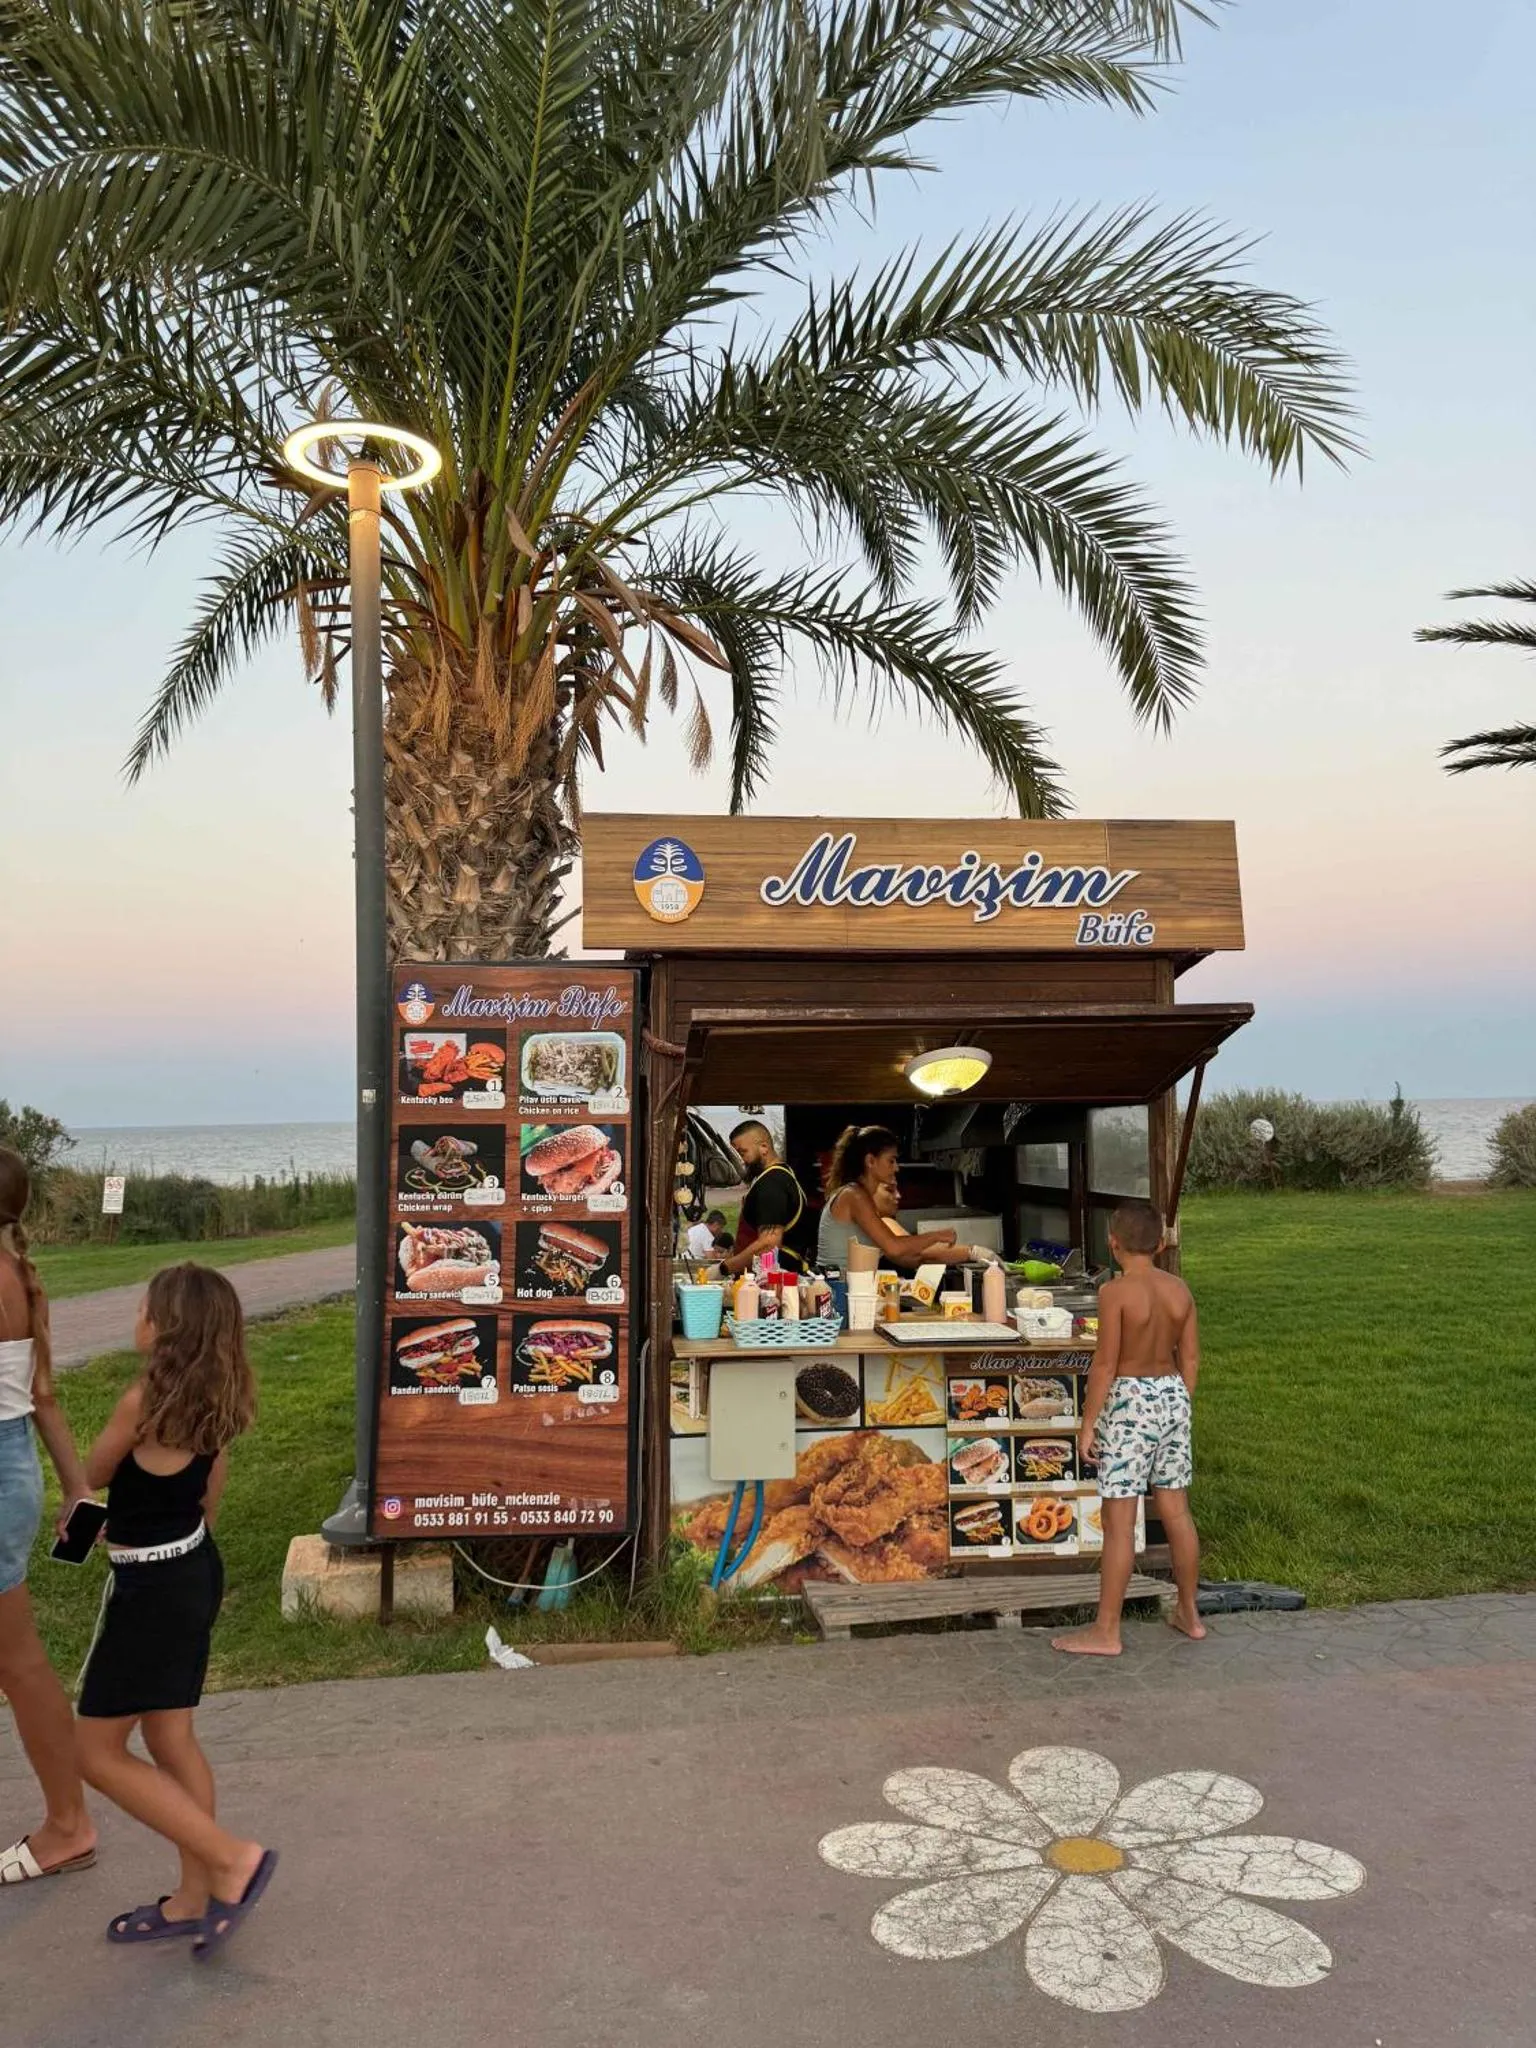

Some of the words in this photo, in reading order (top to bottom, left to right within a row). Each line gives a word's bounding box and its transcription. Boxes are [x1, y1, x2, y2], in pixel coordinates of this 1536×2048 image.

[760, 832, 1140, 922] Mavişim
[1075, 909, 1156, 946] Büfe
[441, 984, 557, 1024] Mavişim
[557, 985, 625, 1030] Büfe
[492, 1080, 497, 1091] 1
[615, 1086, 622, 1098] 2
[400, 1095, 437, 1106] Kentucky
[439, 1095, 454, 1104] box
[519, 1095, 538, 1104] Pilav
[519, 1106, 549, 1115] Chicken
[564, 1107, 580, 1115] rice
[488, 1177, 495, 1188] 3
[614, 1184, 621, 1194] 4
[398, 1192, 435, 1202] Kentucky
[436, 1192, 463, 1200] dürüm
[521, 1193, 556, 1202] Kentucky
[559, 1194, 585, 1202] burger
[398, 1204, 431, 1212] Chicken
[432, 1205, 453, 1213] wrap
[489, 1275, 496, 1285] 5
[611, 1276, 618, 1287] 6
[396, 1291, 428, 1300] Kentucky
[517, 1288, 533, 1298] Hot
[535, 1288, 553, 1299] dog
[486, 1377, 492, 1388] 7
[604, 1372, 611, 1384] 8
[424, 1385, 461, 1394] sandwich
[414, 1513, 444, 1527] 0533
[448, 1512, 470, 1526] 881
[475, 1511, 488, 1525] 91
[493, 1511, 508, 1524] 55
[520, 1511, 550, 1524] 0533
[554, 1510, 576, 1524] 840
[580, 1510, 594, 1523] 72
[598, 1510, 614, 1523] 90
